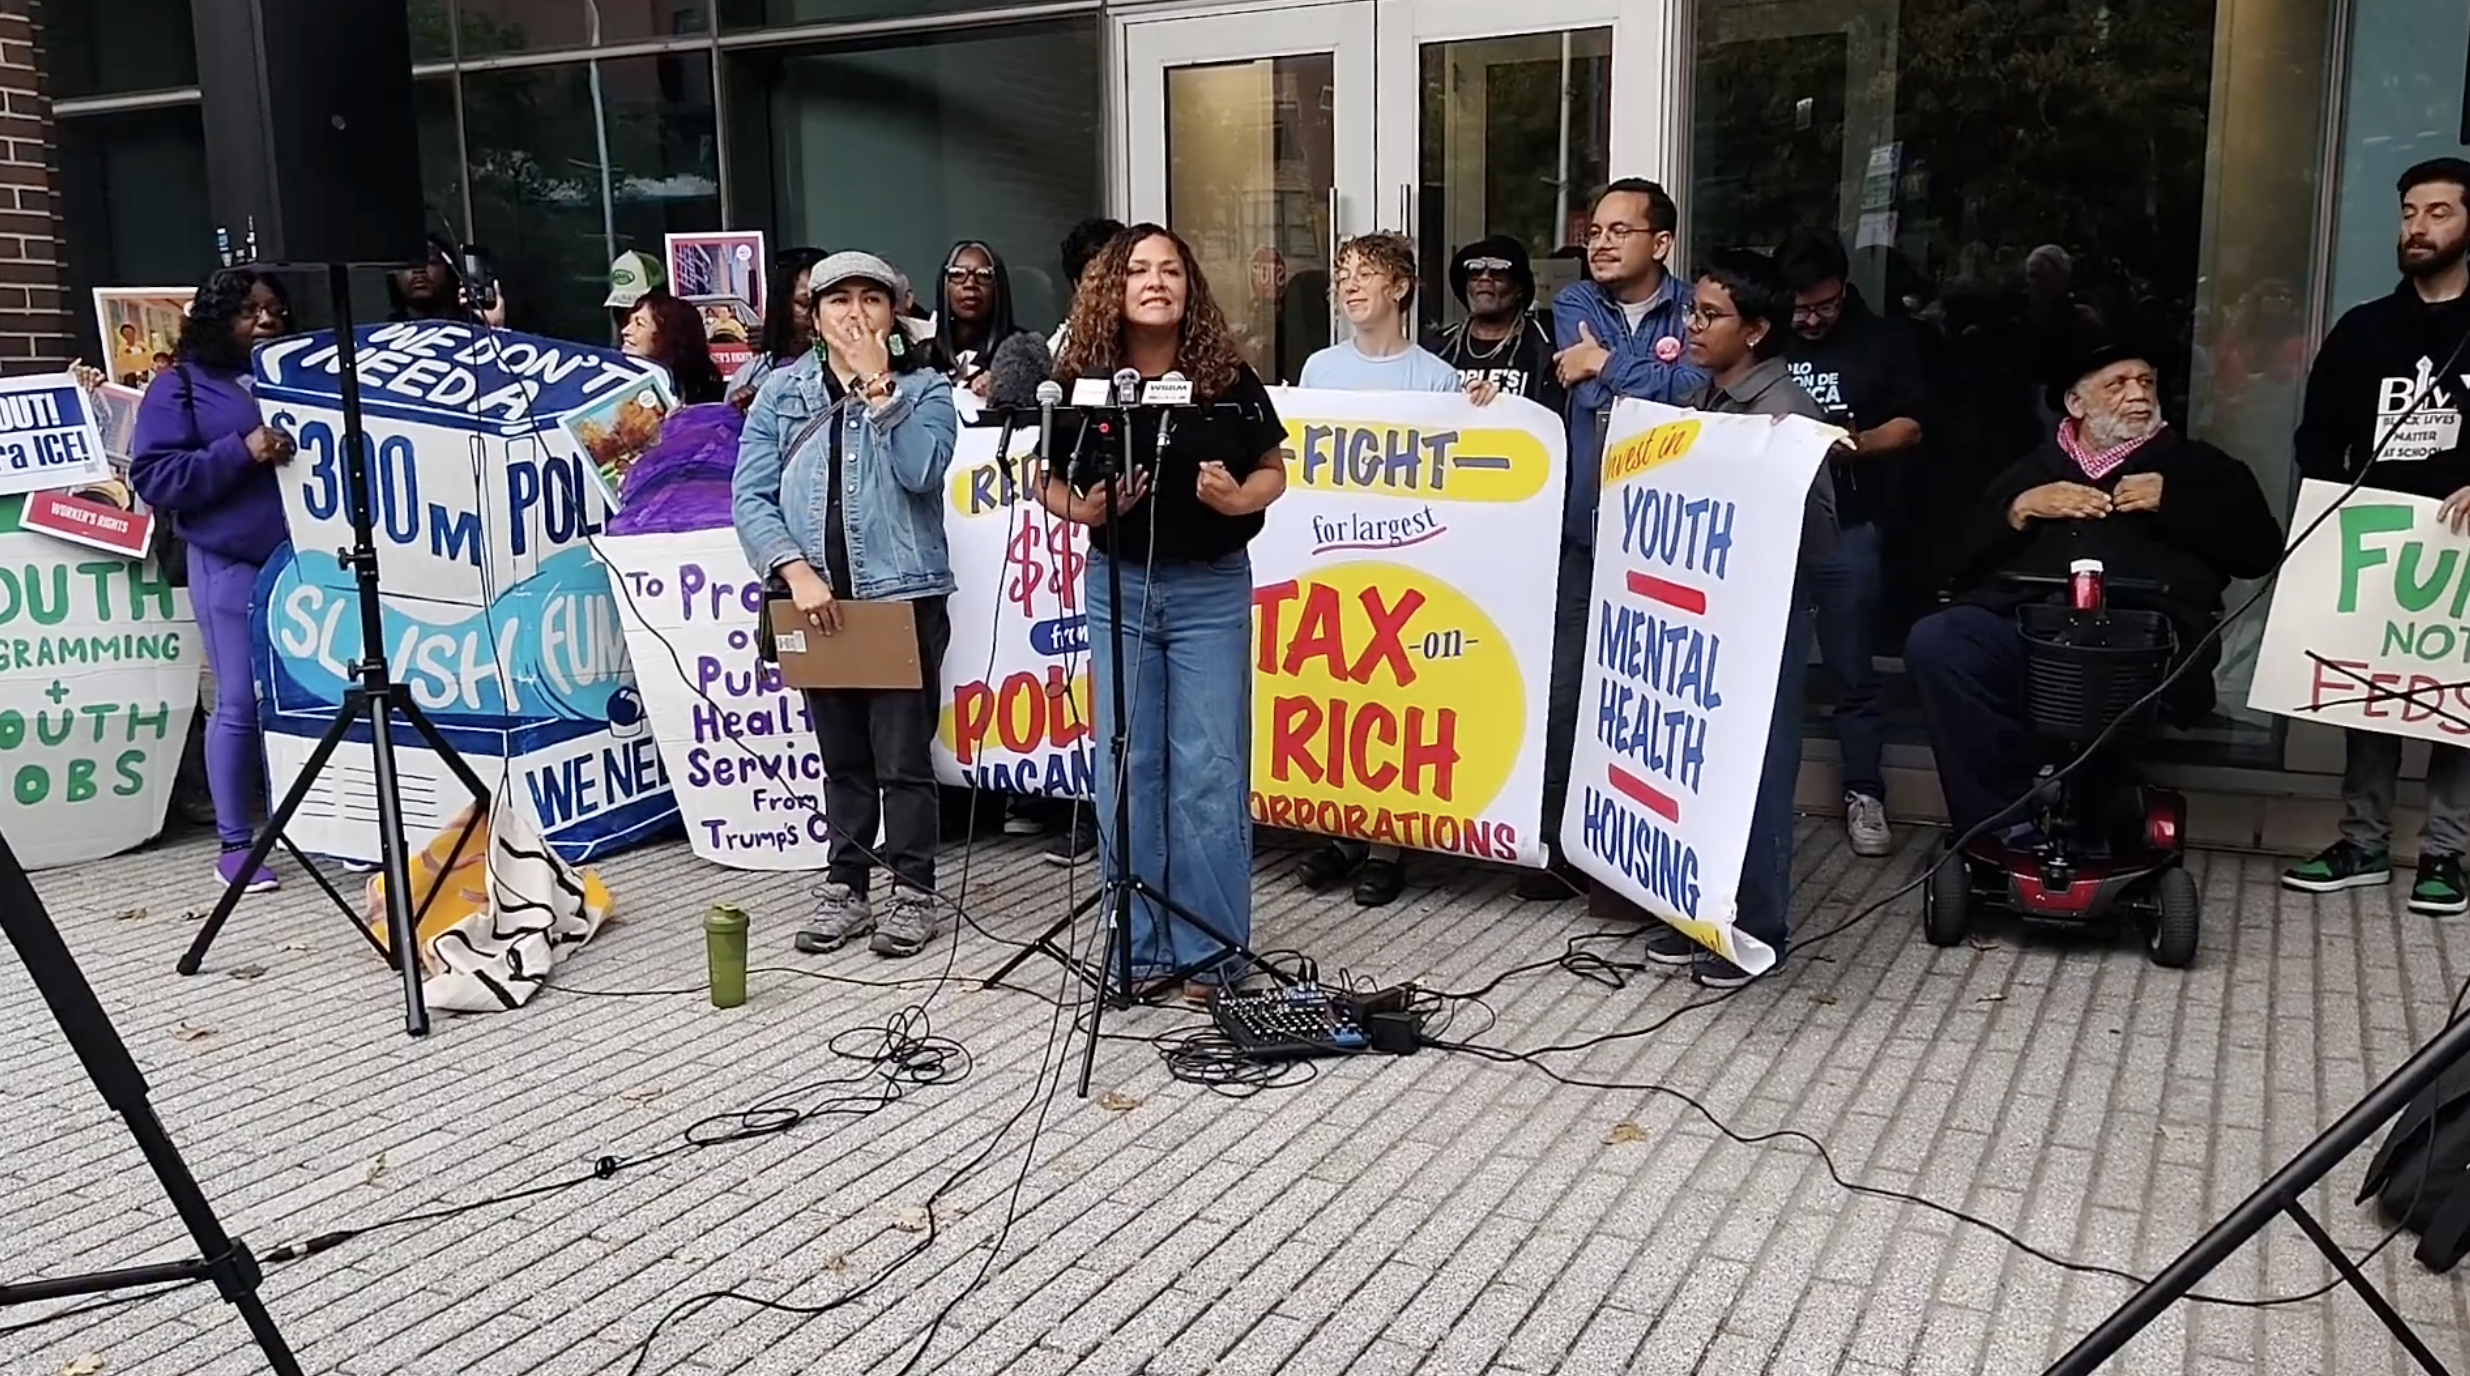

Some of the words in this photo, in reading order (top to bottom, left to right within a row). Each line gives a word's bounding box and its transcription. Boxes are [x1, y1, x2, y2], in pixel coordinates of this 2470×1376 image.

[300, 343, 477, 406] NEED
[468, 378, 539, 422] A
[367, 322, 472, 358] WE
[453, 333, 646, 394] DON'T
[1817, 372, 1839, 386] DE
[1806, 385, 1841, 404] CA
[33, 431, 91, 466] ICE!
[1658, 425, 1687, 459] in
[51, 501, 97, 526] WORKER'S
[96, 515, 129, 533] RIGHTS
[507, 451, 612, 557] POL
[1313, 514, 1348, 544] for
[1353, 504, 1438, 548] largest
[1622, 484, 1736, 581] YOUTH
[625, 571, 664, 597] To
[1252, 579, 1426, 688] TAX
[1598, 600, 1723, 713] MENTAL
[1270, 695, 1462, 802] RICH
[1598, 677, 1708, 795] HEALTH
[525, 753, 599, 830] WE
[753, 788, 818, 812] From
[701, 819, 799, 855] Trump's
[1583, 786, 1700, 921] HOUSING
